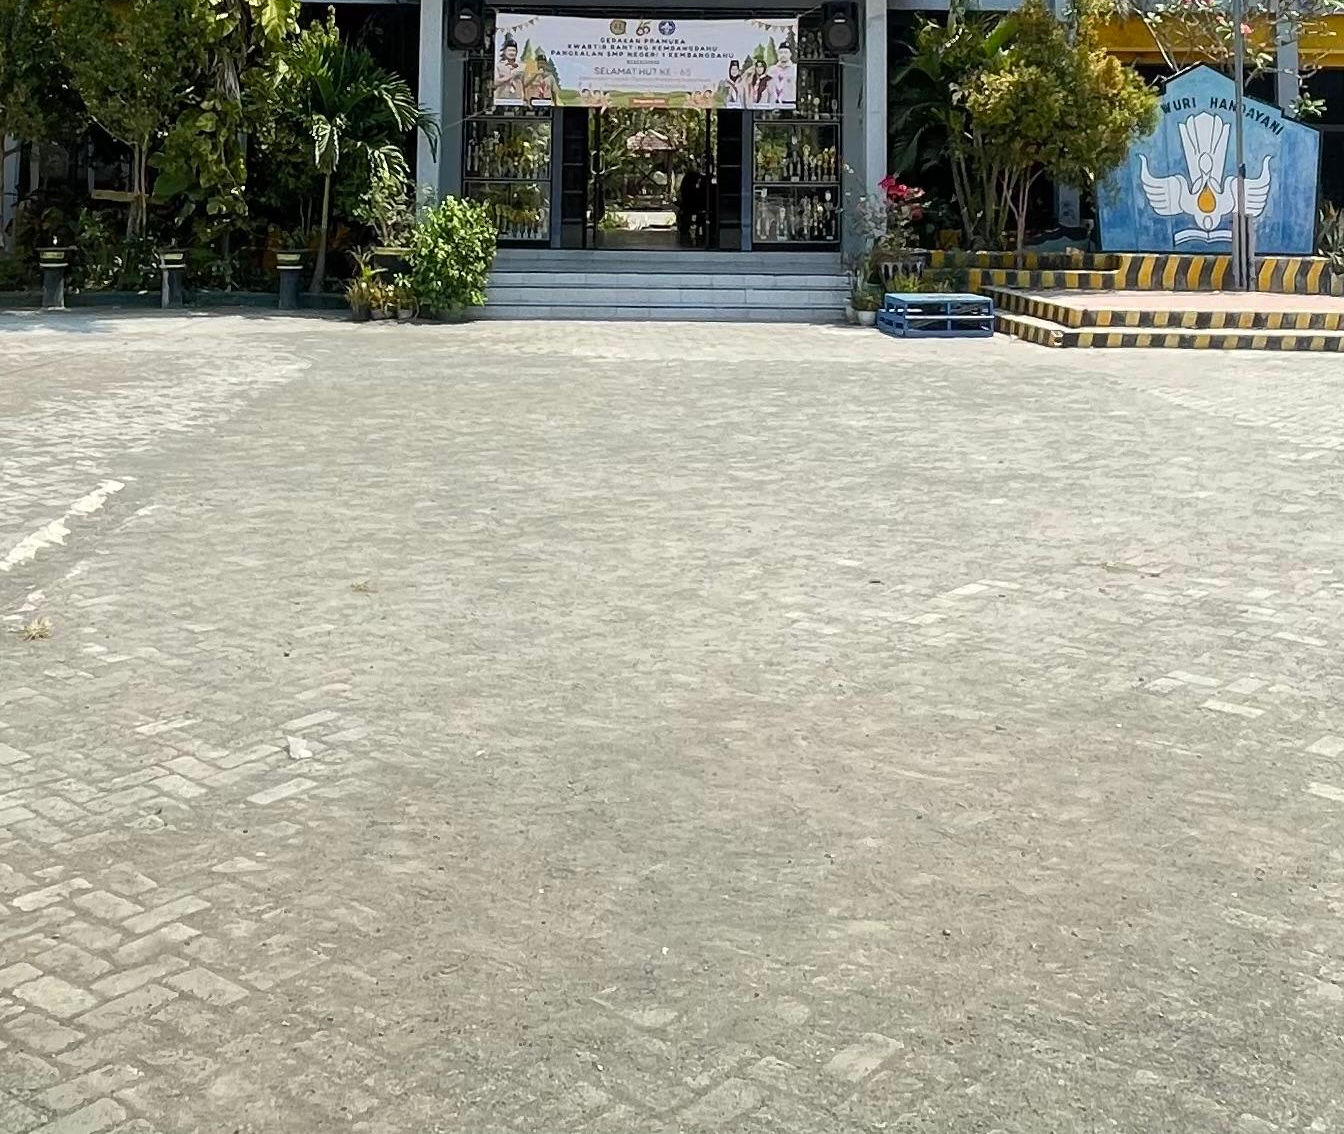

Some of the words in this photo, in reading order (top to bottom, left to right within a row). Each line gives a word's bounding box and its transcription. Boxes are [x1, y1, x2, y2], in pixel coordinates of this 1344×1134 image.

[593, 66, 637, 76] SELAMAT
[639, 68, 657, 76] HUT
[1160, 97, 1197, 114] WURI
